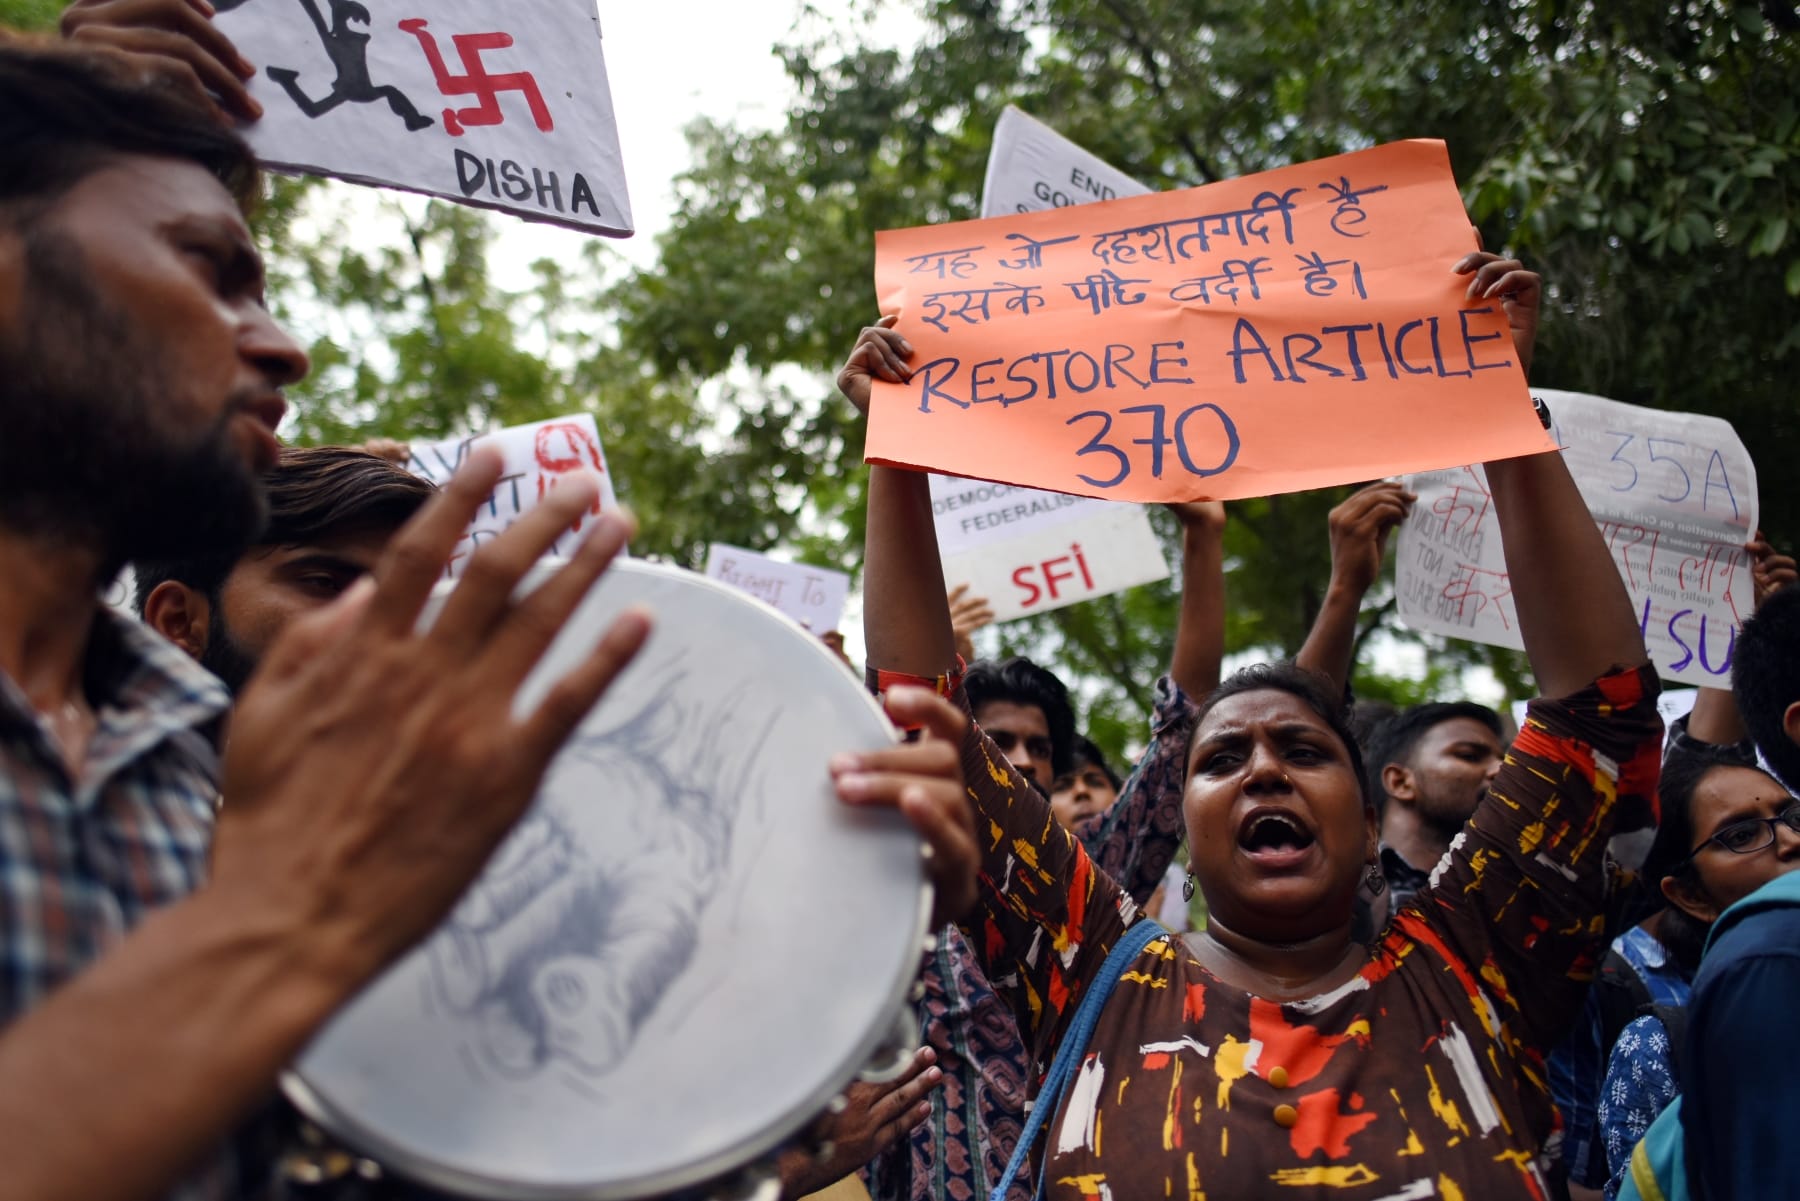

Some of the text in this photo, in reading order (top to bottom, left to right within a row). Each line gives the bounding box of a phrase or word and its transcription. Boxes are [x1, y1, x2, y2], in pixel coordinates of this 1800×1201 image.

[454, 148, 600, 217] DISHA
[1034, 181, 1076, 208] GO
[1071, 167, 1116, 201] END
[904, 246, 985, 279] यह
[999, 233, 1079, 269] जो
[1318, 176, 1388, 237] है
[1169, 257, 1272, 306] वर्दी
[909, 307, 1511, 413] RESTORE ARTICLE
[1066, 402, 1240, 488] 370
[933, 484, 1024, 516] DEMOC
[1605, 430, 1738, 520] 35A
[960, 494, 1086, 534] FEDERALIS
